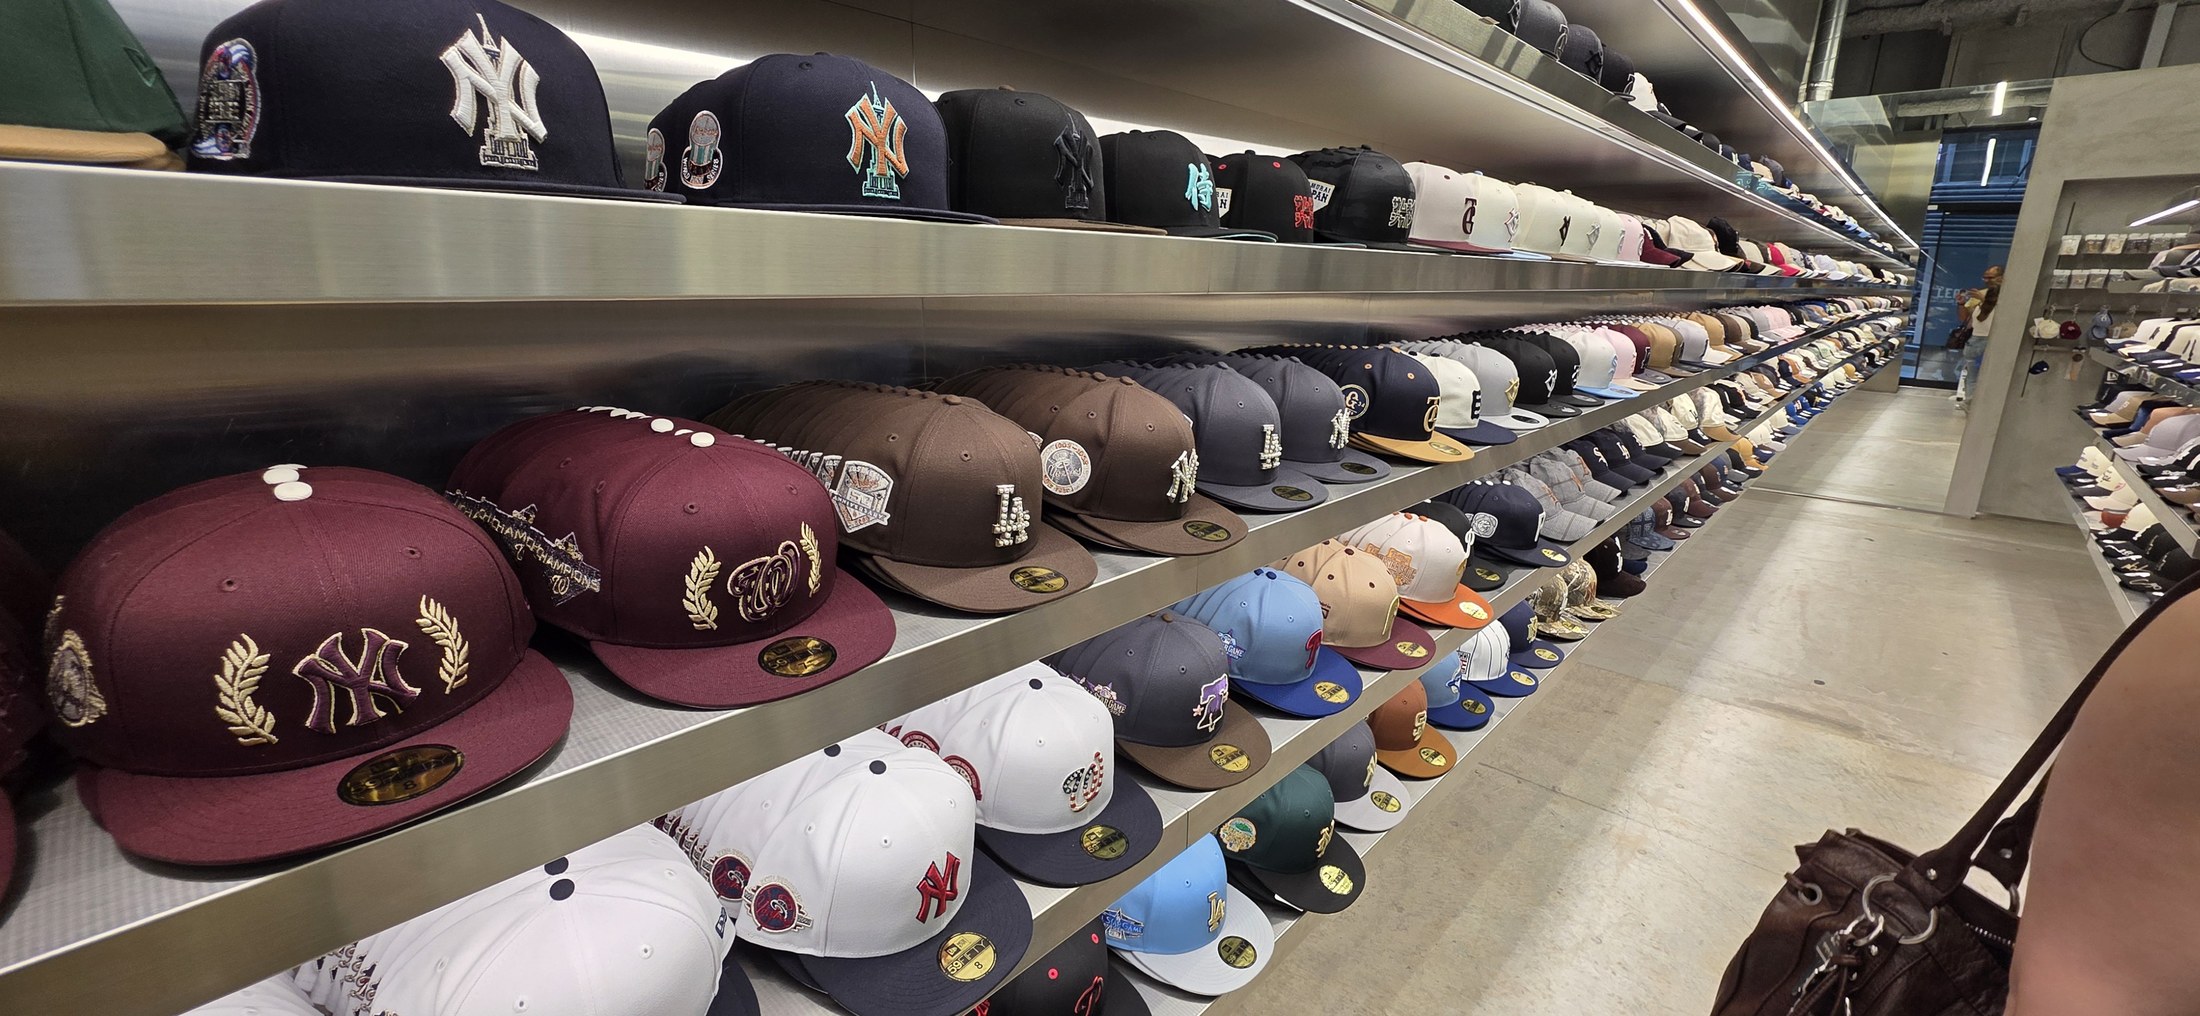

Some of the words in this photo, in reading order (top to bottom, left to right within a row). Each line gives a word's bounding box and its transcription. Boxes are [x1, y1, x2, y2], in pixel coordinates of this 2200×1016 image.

[439, 28, 548, 145] NY
[845, 92, 910, 179] NY
[1053, 125, 1095, 193] NY
[1184, 163, 1213, 212] 侍
[1310, 183, 1331, 194] MURAI
[1311, 190, 1329, 203] PAN
[1259, 424, 1282, 470] LA
[992, 484, 1031, 548] LA
[535, 547, 601, 593] CHAMPIONS
[292, 628, 422, 734] NY
[916, 851, 961, 924] NY
[1207, 891, 1226, 933] LA
[947, 939, 987, 975] 59FIFTY
[974, 961, 984, 970] 8
